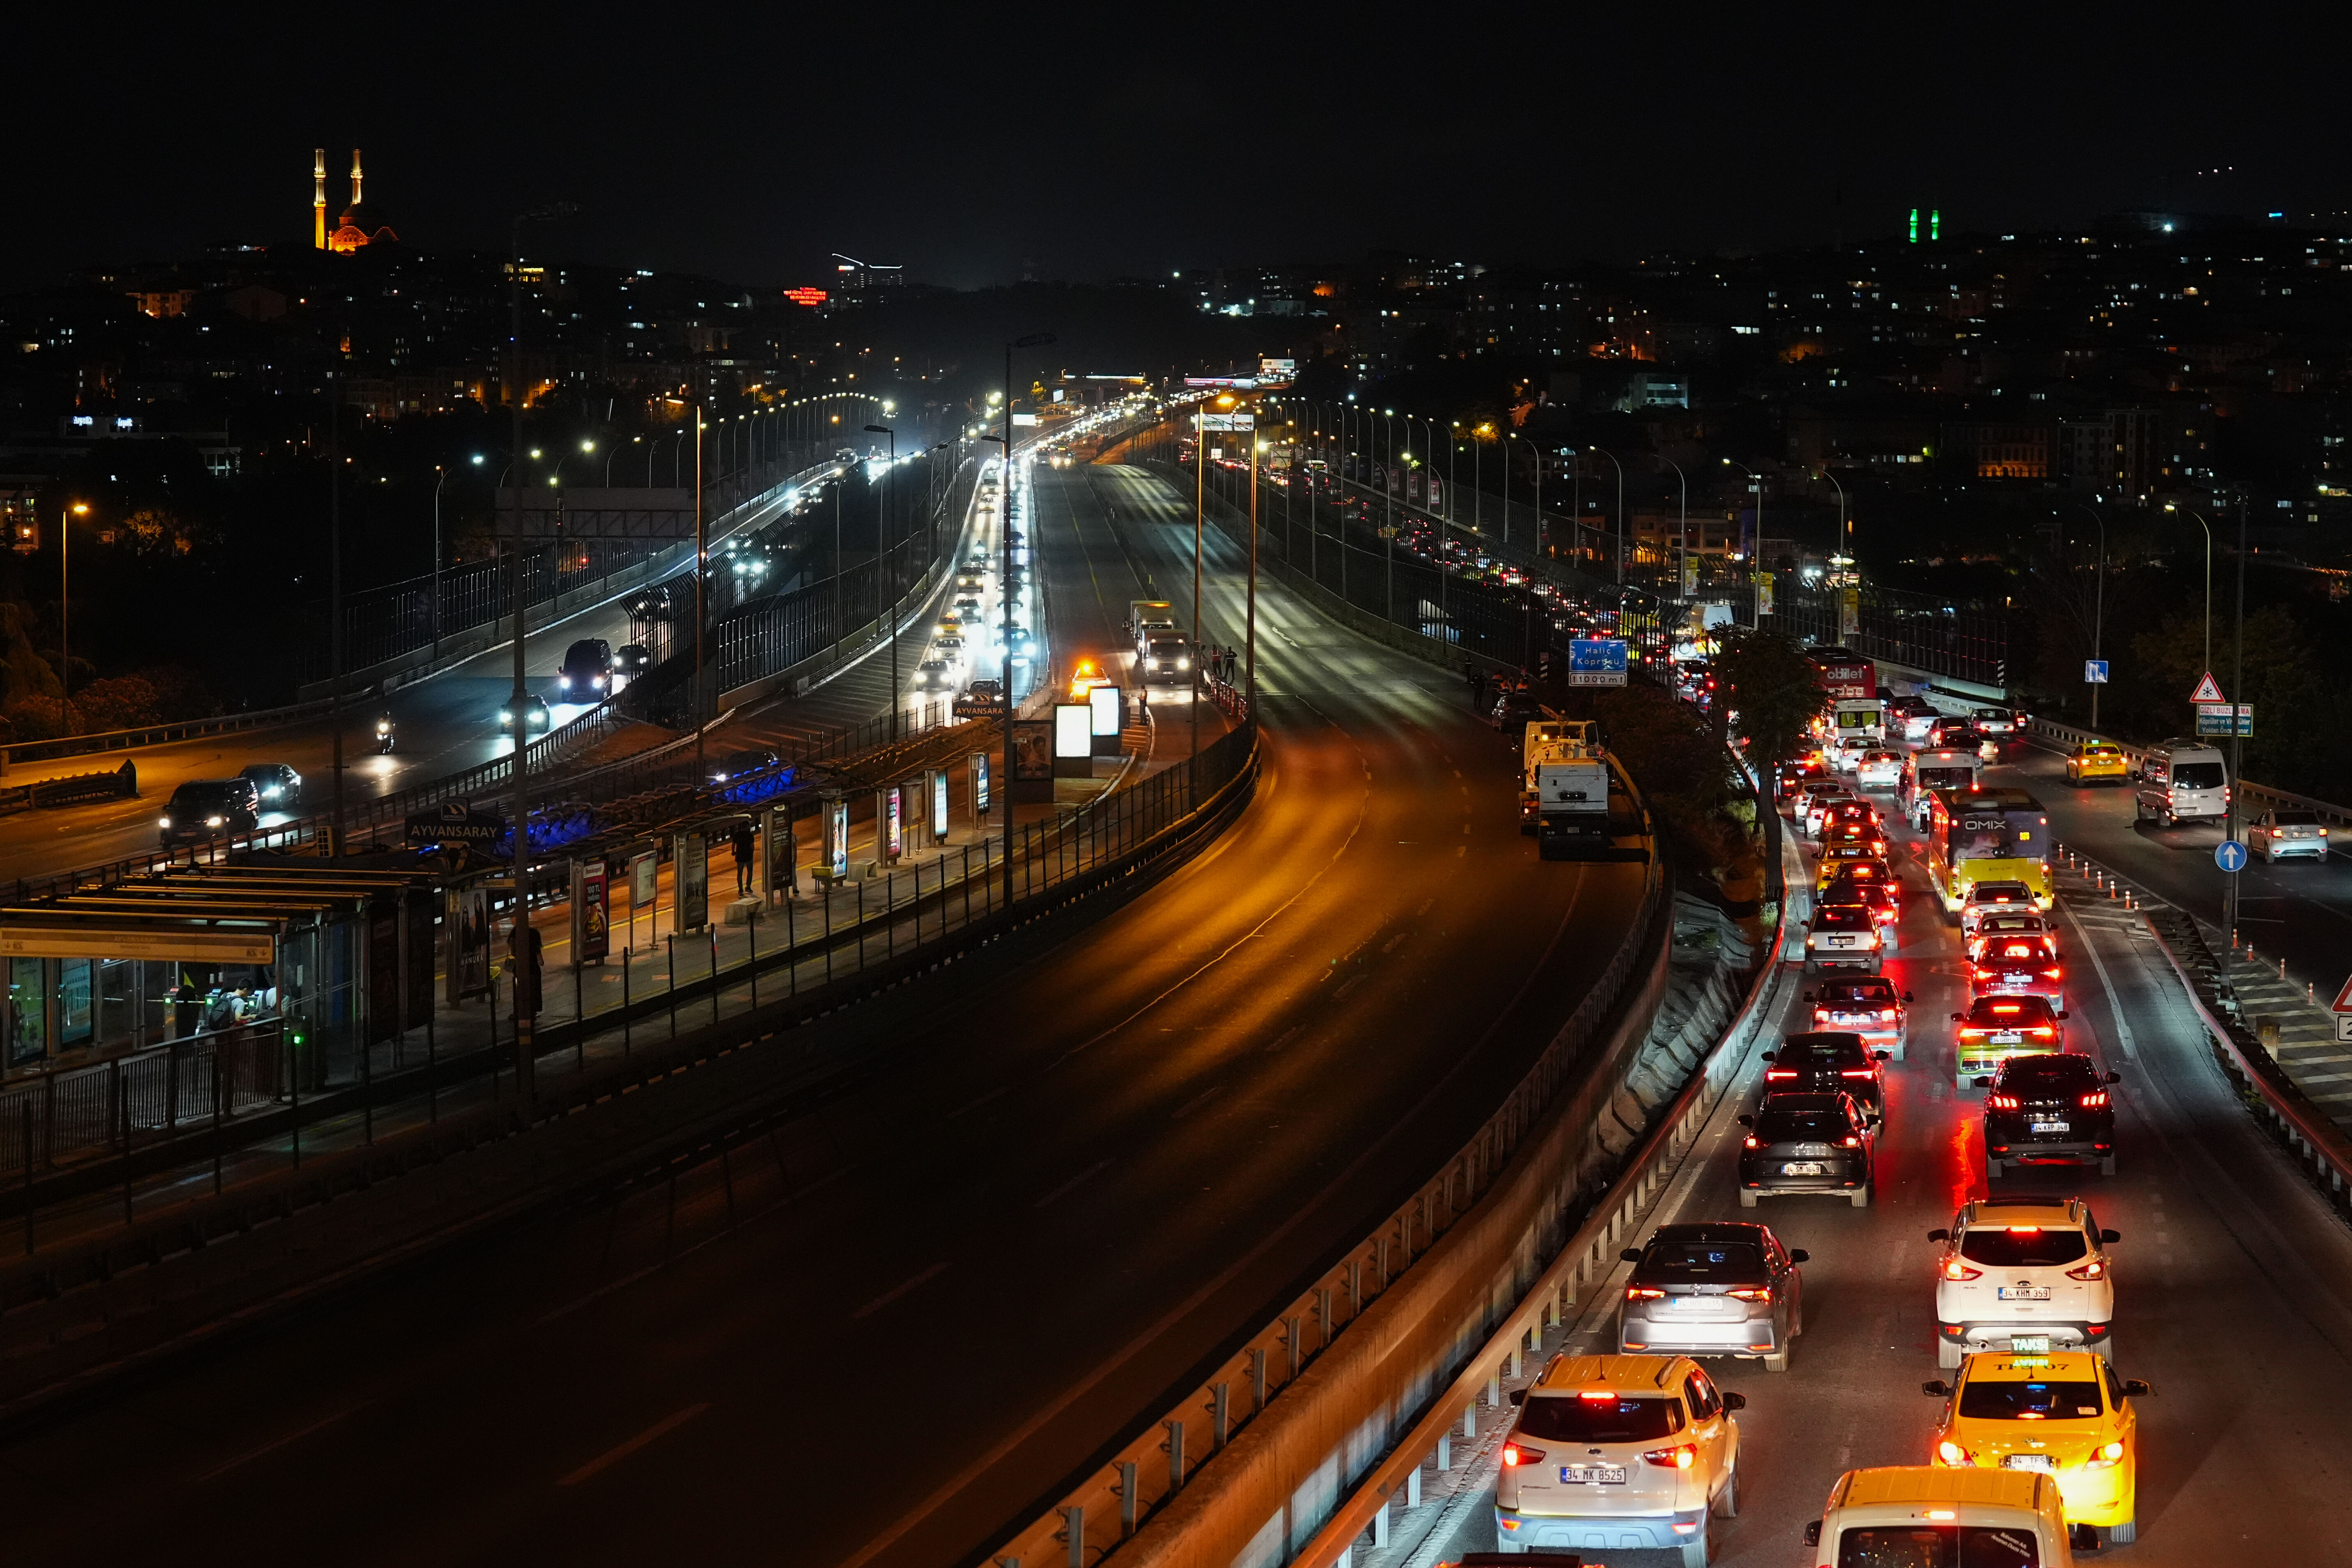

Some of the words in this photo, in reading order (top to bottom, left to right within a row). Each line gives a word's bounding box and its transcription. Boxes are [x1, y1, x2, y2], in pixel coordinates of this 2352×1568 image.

[1827, 667, 1863, 679] obilet
[1965, 820, 2006, 830] OMIX
[411, 825, 498, 838] AYVANSARAY
[2011, 1338, 2049, 1351] TAKSI
[1567, 1470, 1577, 1479] 34
[1583, 1470, 1594, 1480] MK
[1599, 1470, 1622, 1480] 8525
